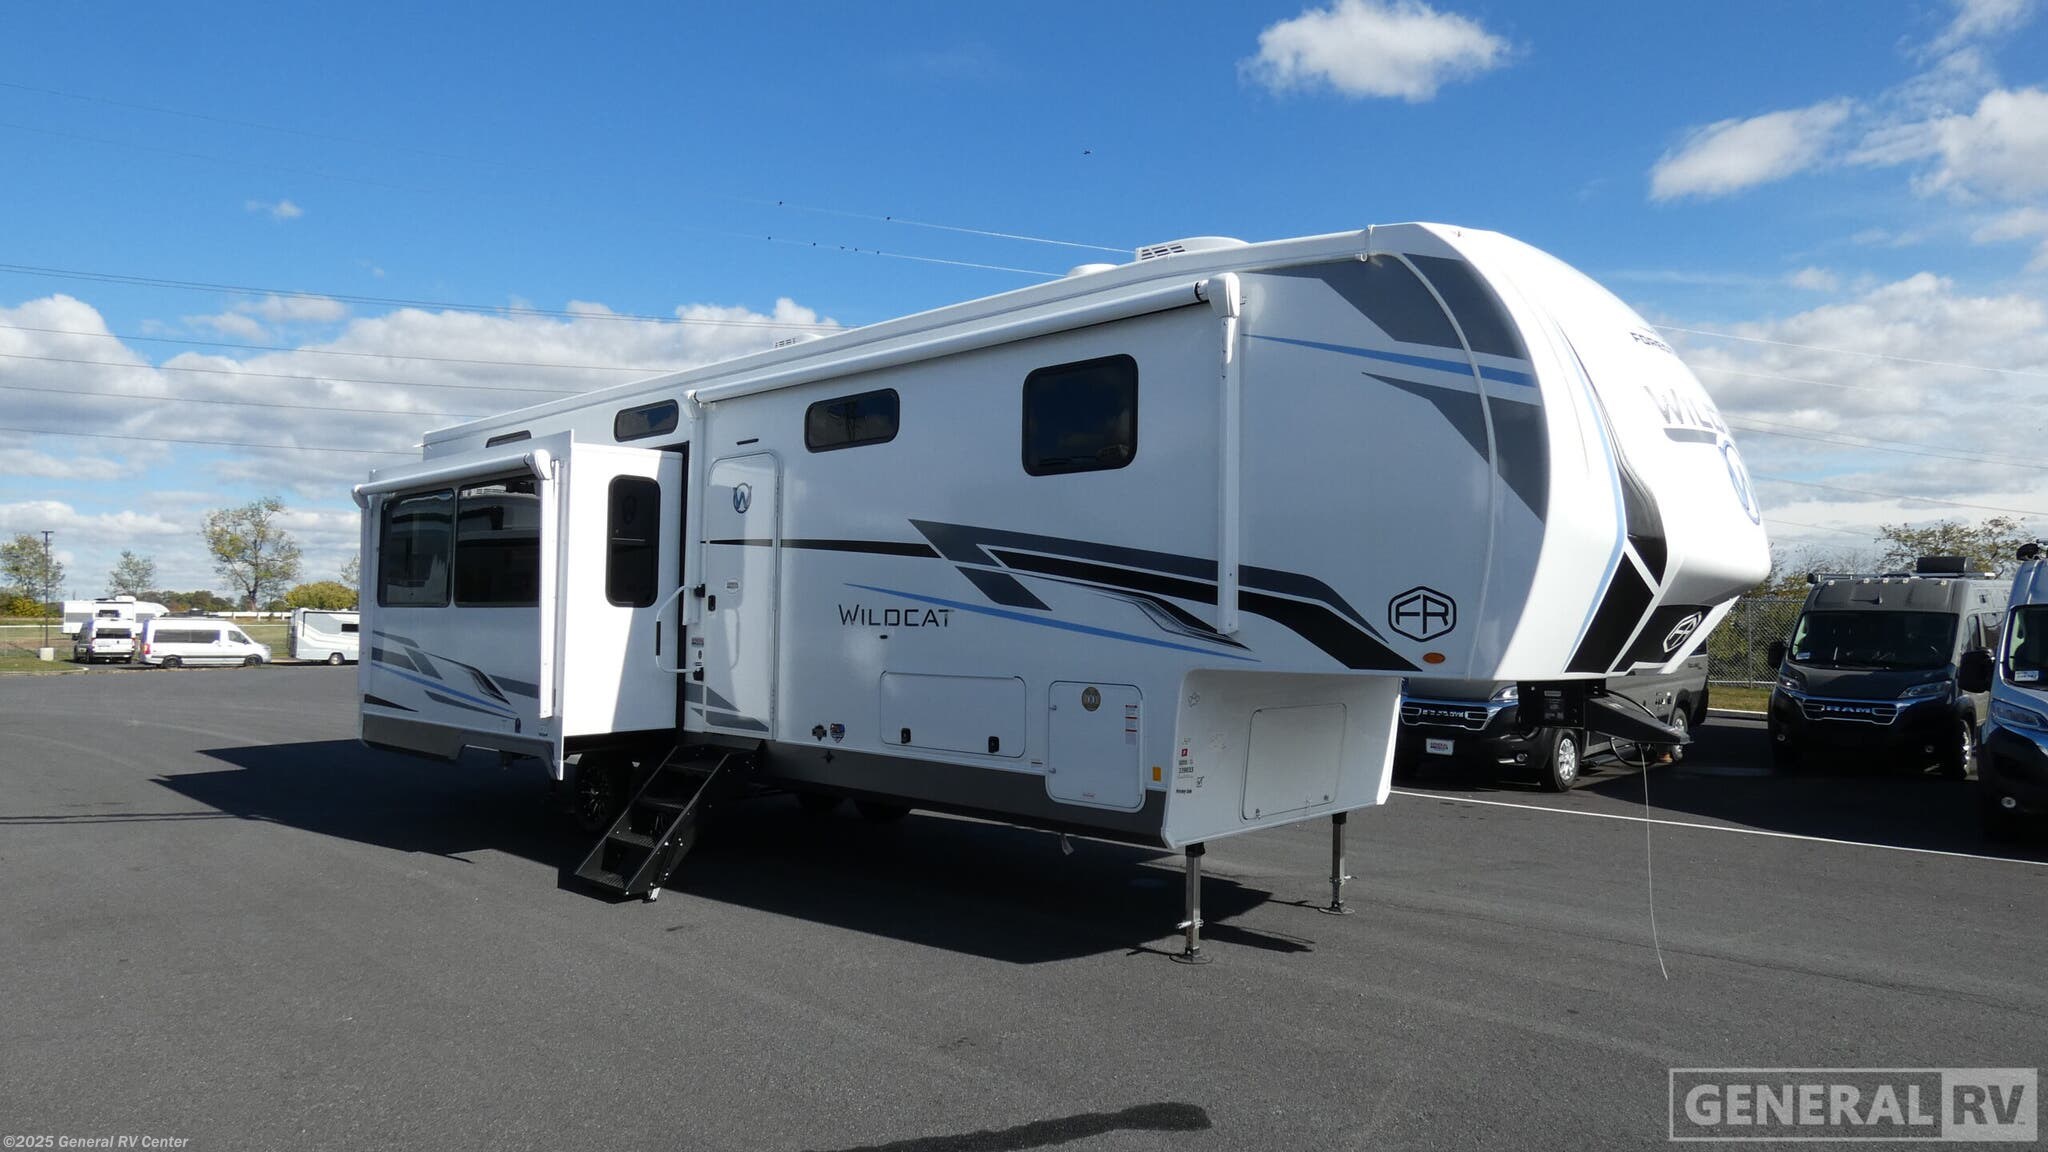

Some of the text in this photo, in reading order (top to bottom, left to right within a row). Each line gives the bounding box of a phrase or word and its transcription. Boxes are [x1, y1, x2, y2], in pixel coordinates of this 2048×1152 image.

[838, 604, 955, 627] WILDCAT
[1395, 594, 1449, 635] FR
[1826, 705, 1871, 714] RAM
